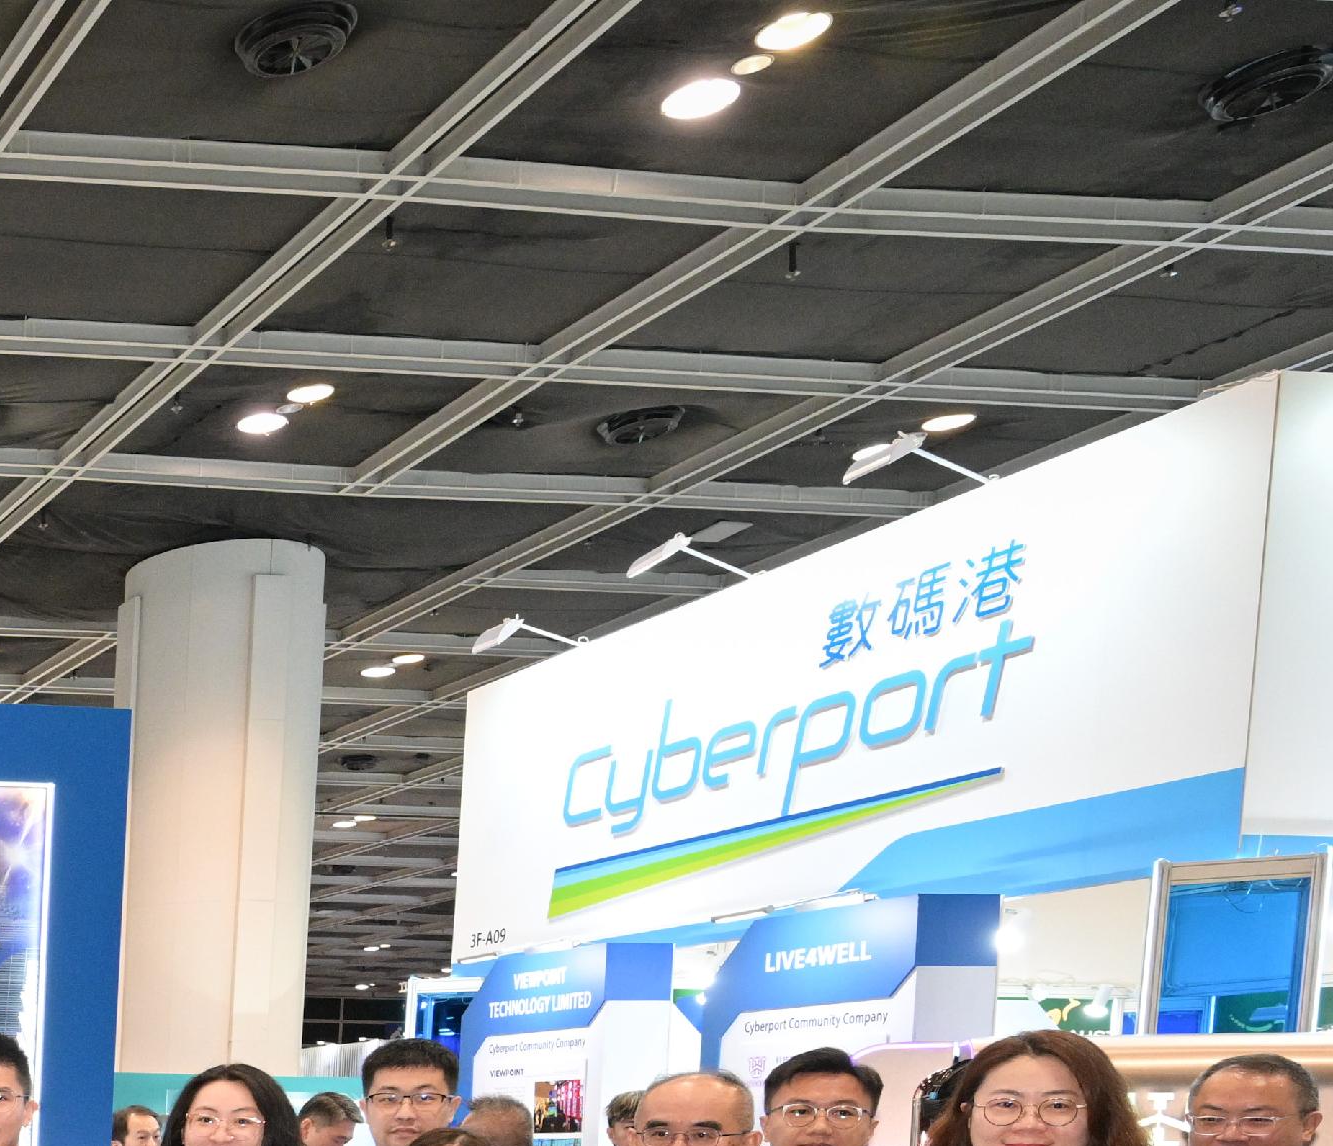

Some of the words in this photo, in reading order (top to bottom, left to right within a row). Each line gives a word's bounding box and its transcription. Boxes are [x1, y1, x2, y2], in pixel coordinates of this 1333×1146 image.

[819, 538, 1026, 668] 數碼港
[563, 619, 1035, 838] Cyberport
[470, 927, 506, 949] 3F-A09
[764, 941, 872, 973] LIVE4WELL
[513, 966, 568, 990] VIEWPOINT
[489, 994, 551, 1018] TECHNOLOGY
[552, 991, 592, 1011] LIMITED
[744, 1019, 787, 1036] Cyberport
[789, 1014, 841, 1030] Community
[843, 1010, 888, 1026] Company
[489, 1042, 518, 1056] Cyberport
[519, 1039, 555, 1051] Community
[556, 1037, 586, 1049] Company
[489, 1068, 524, 1078] VIEWPOINT
